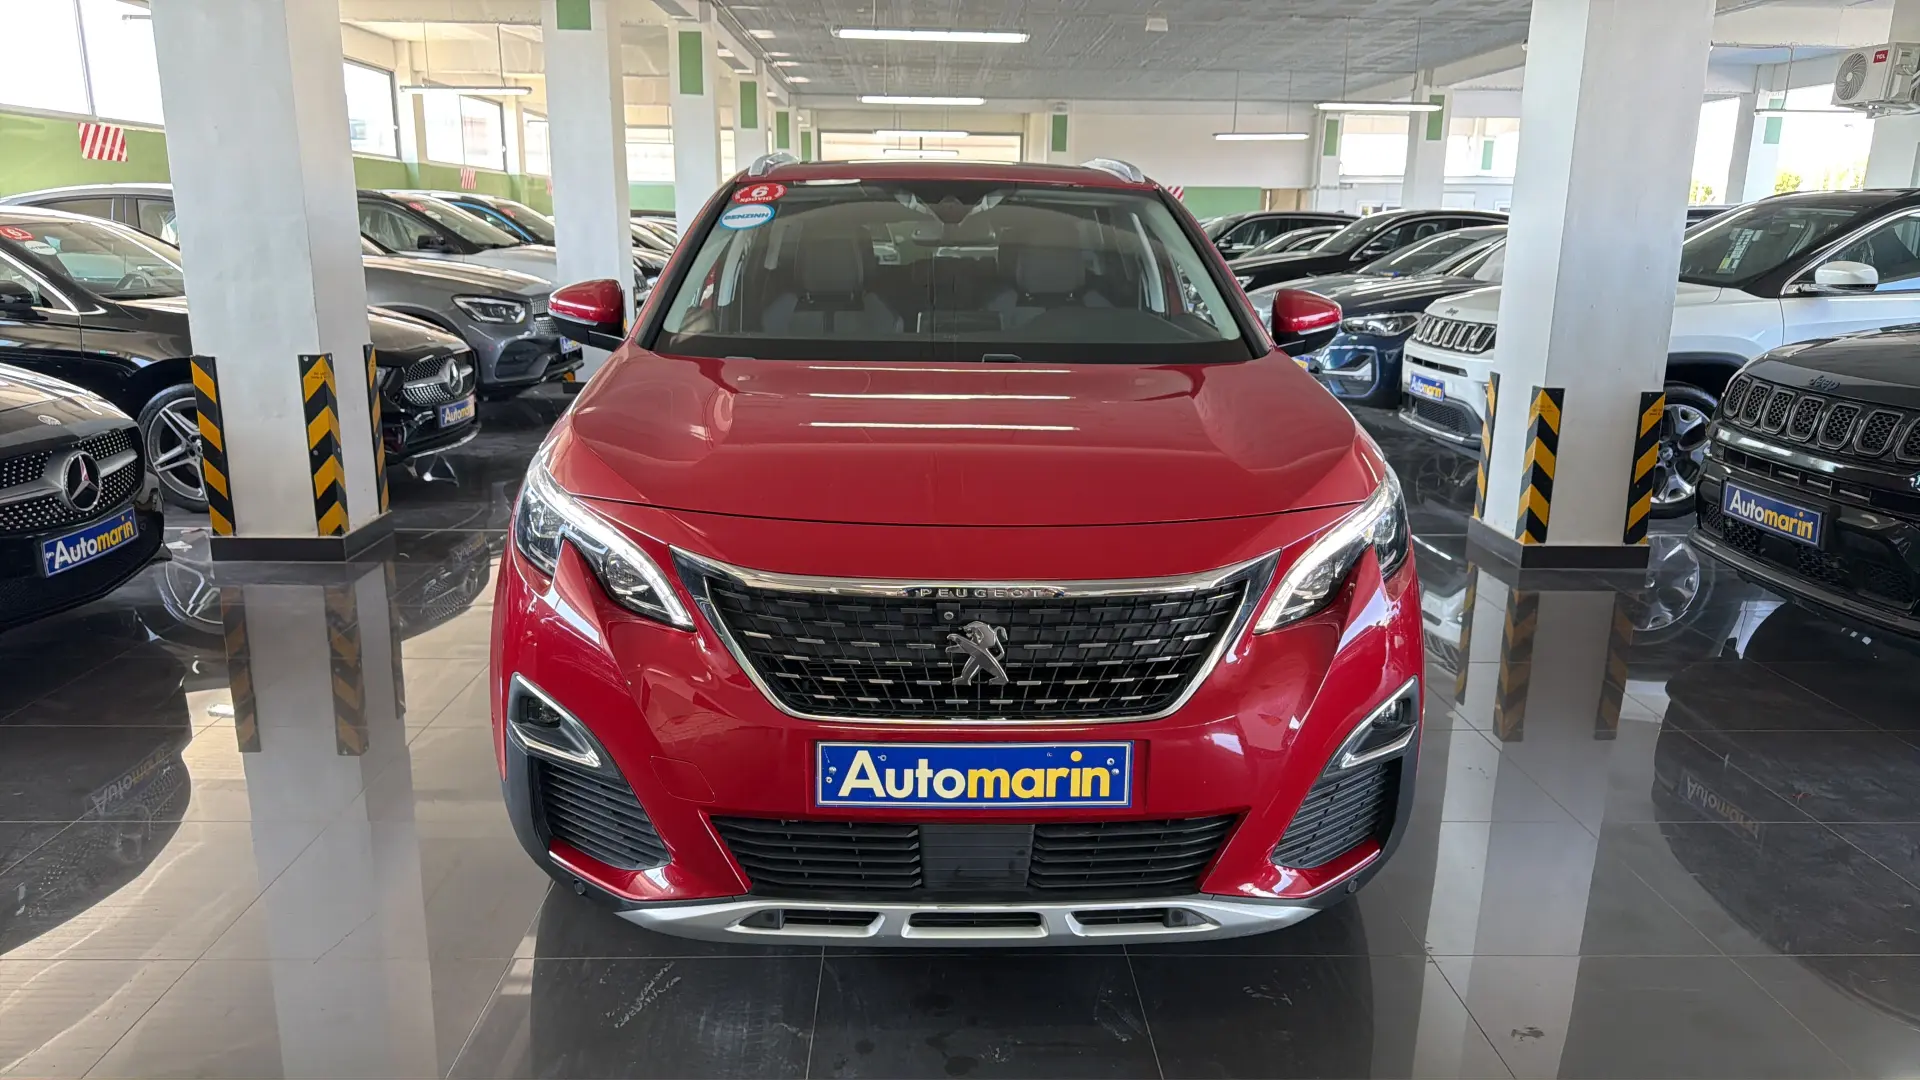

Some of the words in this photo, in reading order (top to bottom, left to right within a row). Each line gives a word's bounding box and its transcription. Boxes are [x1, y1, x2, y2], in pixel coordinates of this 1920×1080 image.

[751, 186, 769, 198] 6
[1729, 489, 1813, 539] Automarin
[54, 515, 134, 569] Automarin
[919, 587, 1043, 598] PEUGEOT
[837, 749, 1111, 799] Automarin
